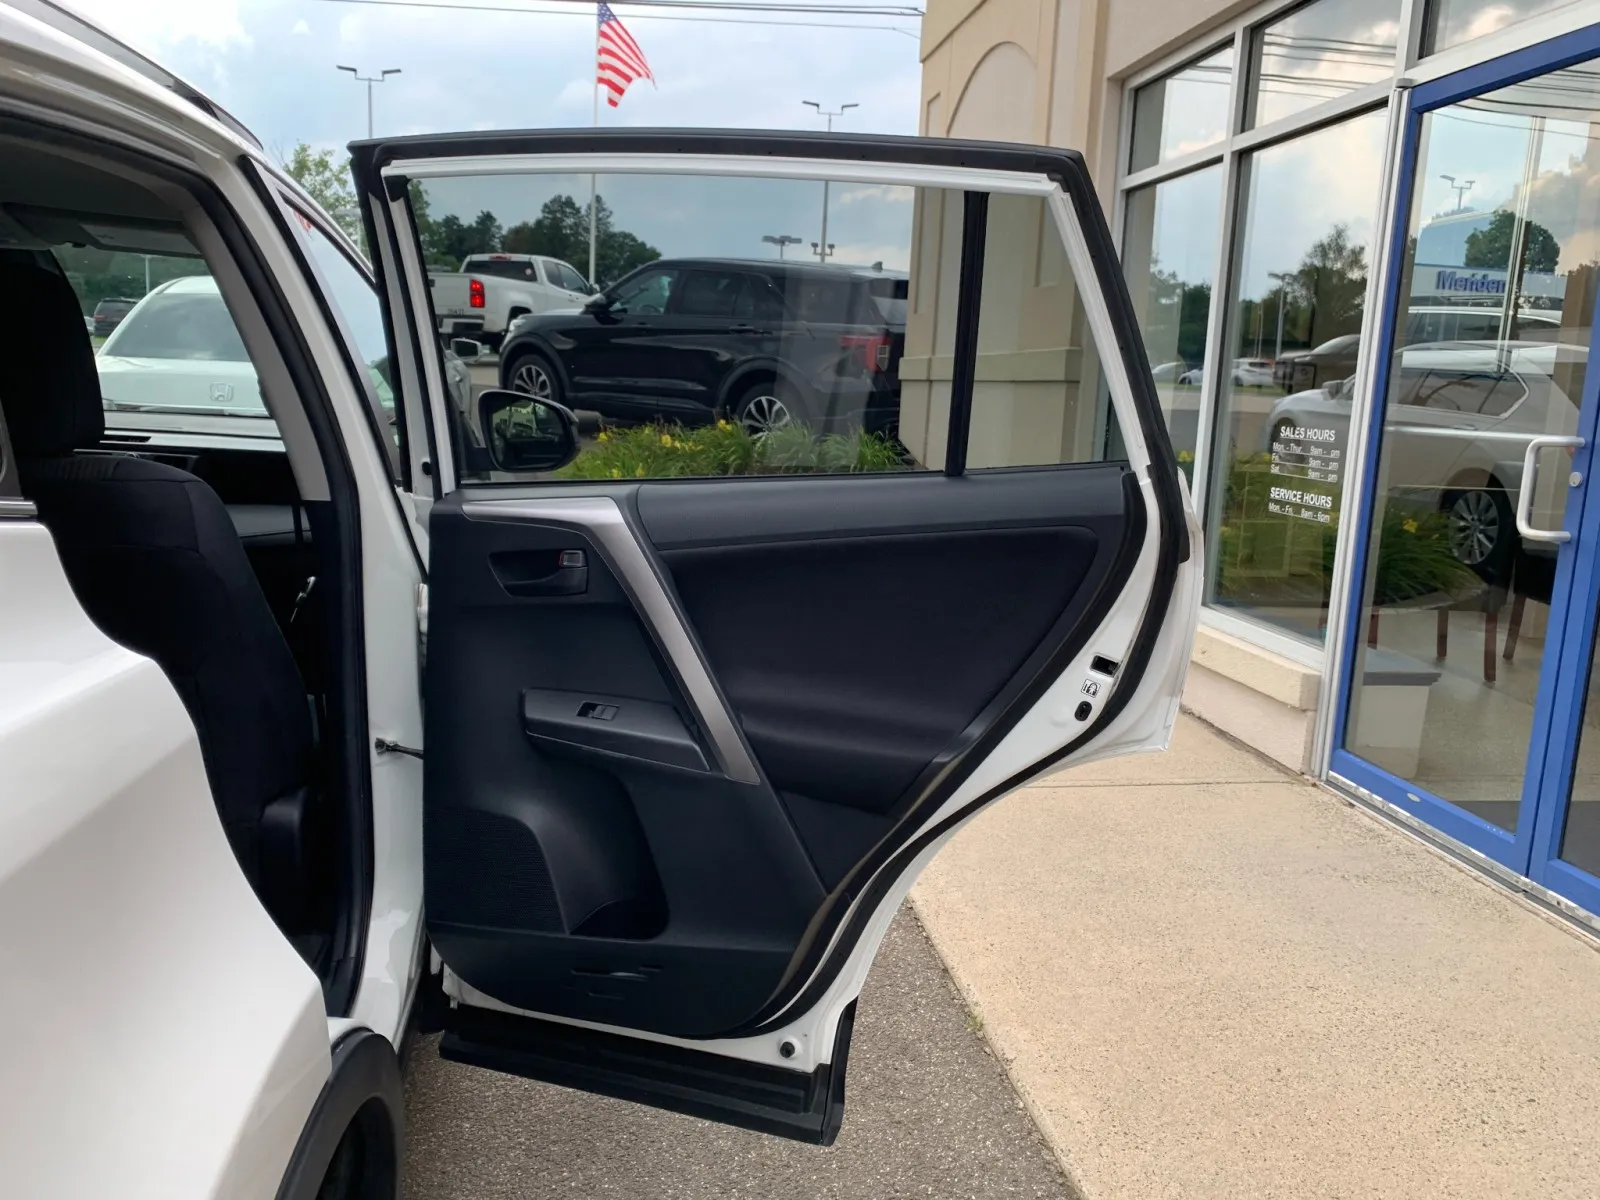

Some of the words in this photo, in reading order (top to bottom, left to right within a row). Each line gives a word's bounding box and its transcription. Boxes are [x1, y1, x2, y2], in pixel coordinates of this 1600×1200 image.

[1436, 270, 1506, 293] Meriden
[1280, 426, 1305, 438] SALES
[1306, 428, 1335, 441] HOURS
[1270, 487, 1302, 502] SERVICE
[1303, 492, 1332, 508] HOURS
